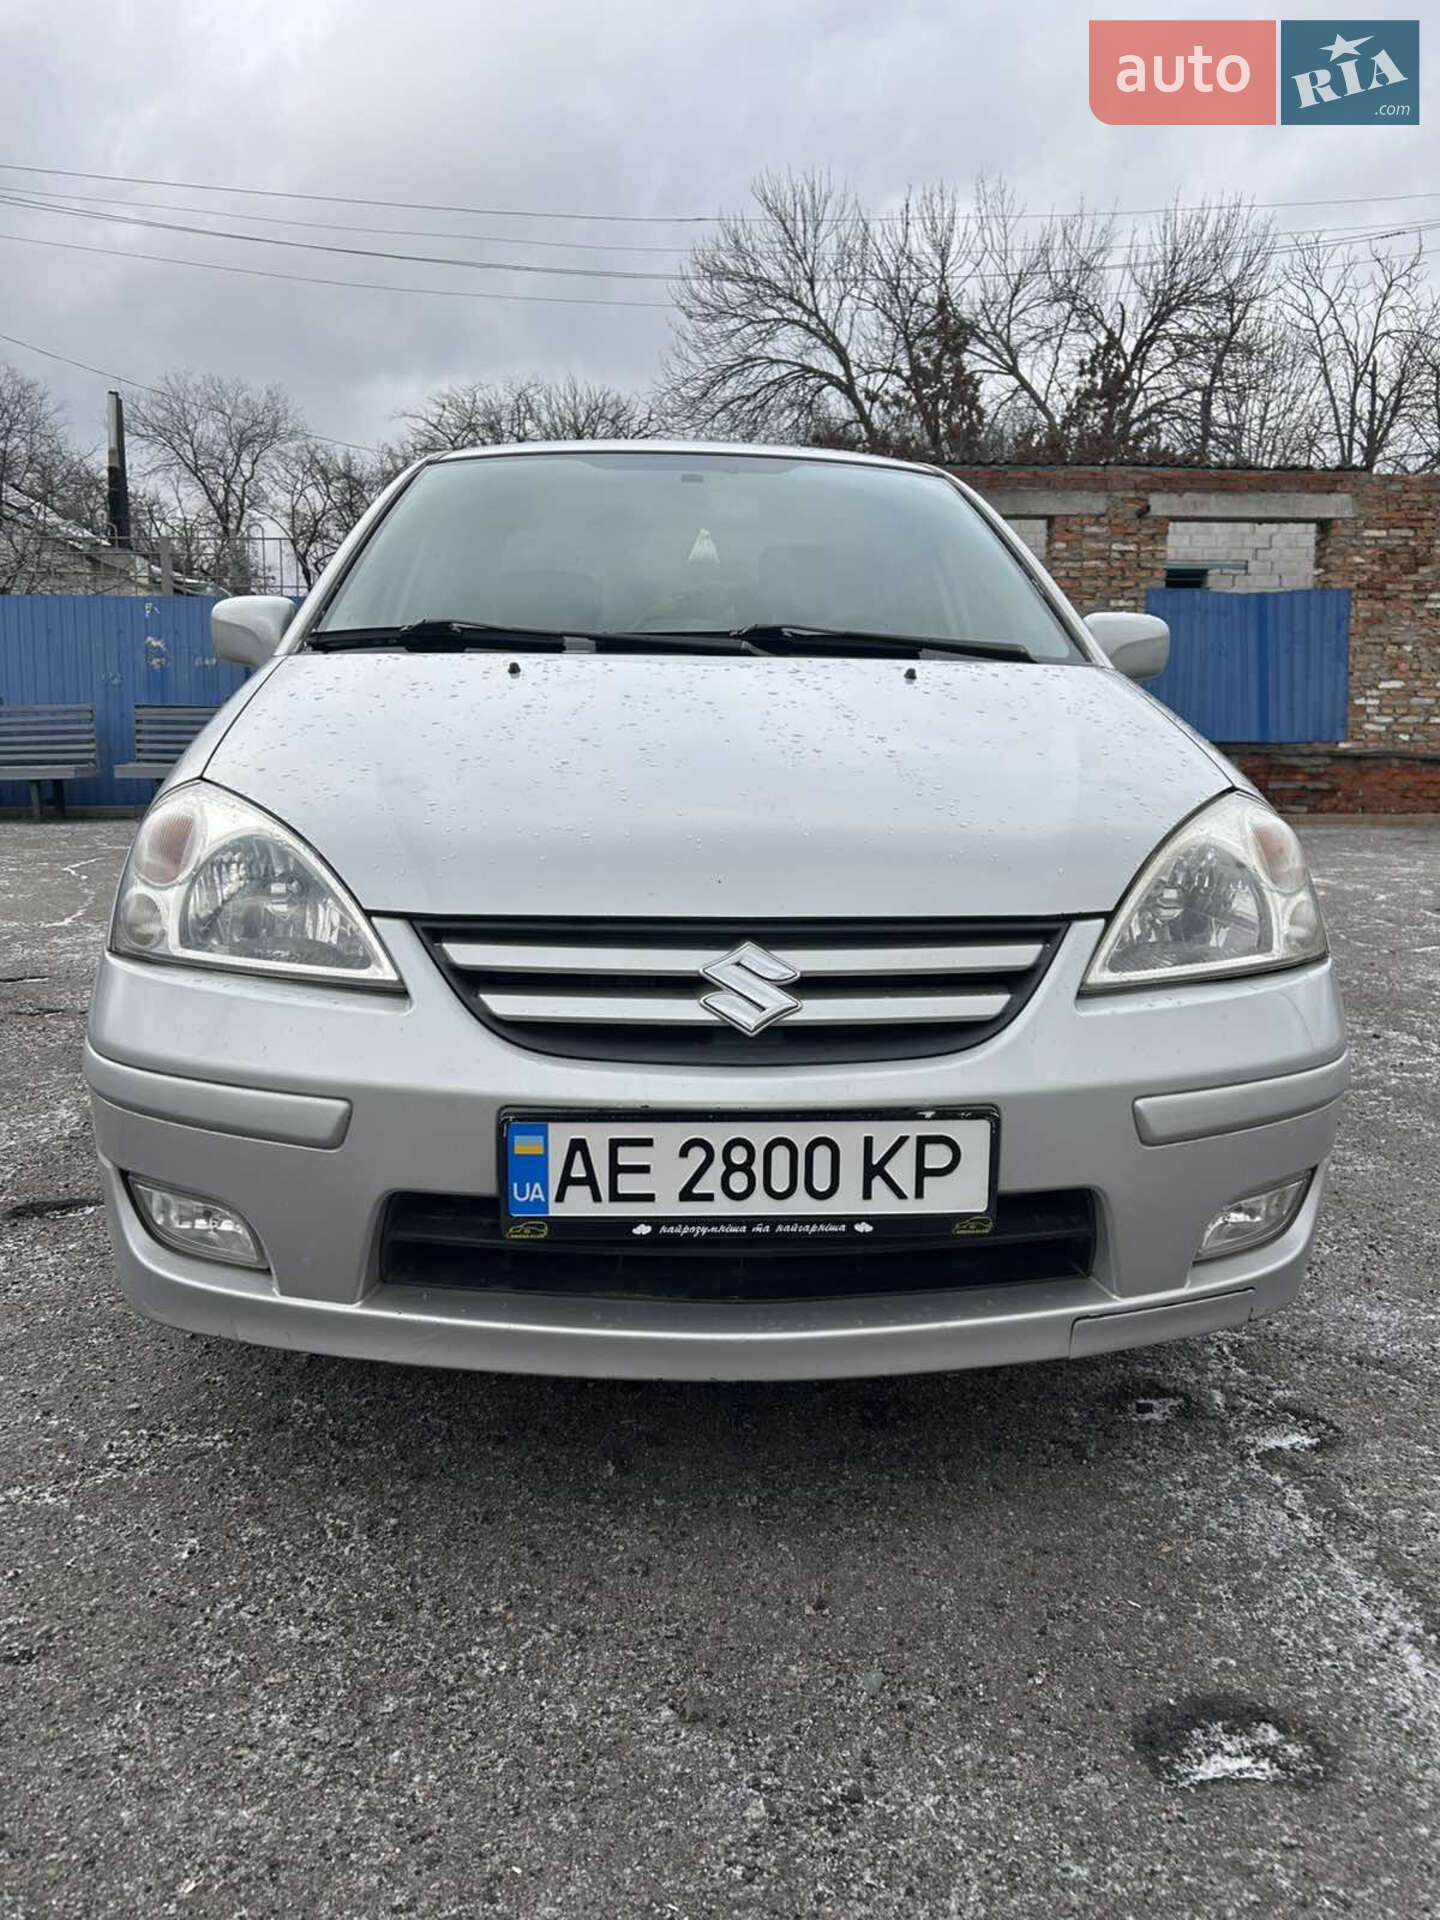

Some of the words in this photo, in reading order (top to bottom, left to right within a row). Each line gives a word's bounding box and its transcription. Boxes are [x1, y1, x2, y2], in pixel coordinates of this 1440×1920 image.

[553, 1137, 656, 1203] AE
[677, 1135, 841, 1202] 2800
[862, 1134, 962, 1200] KP
[512, 1182, 546, 1202] UA
